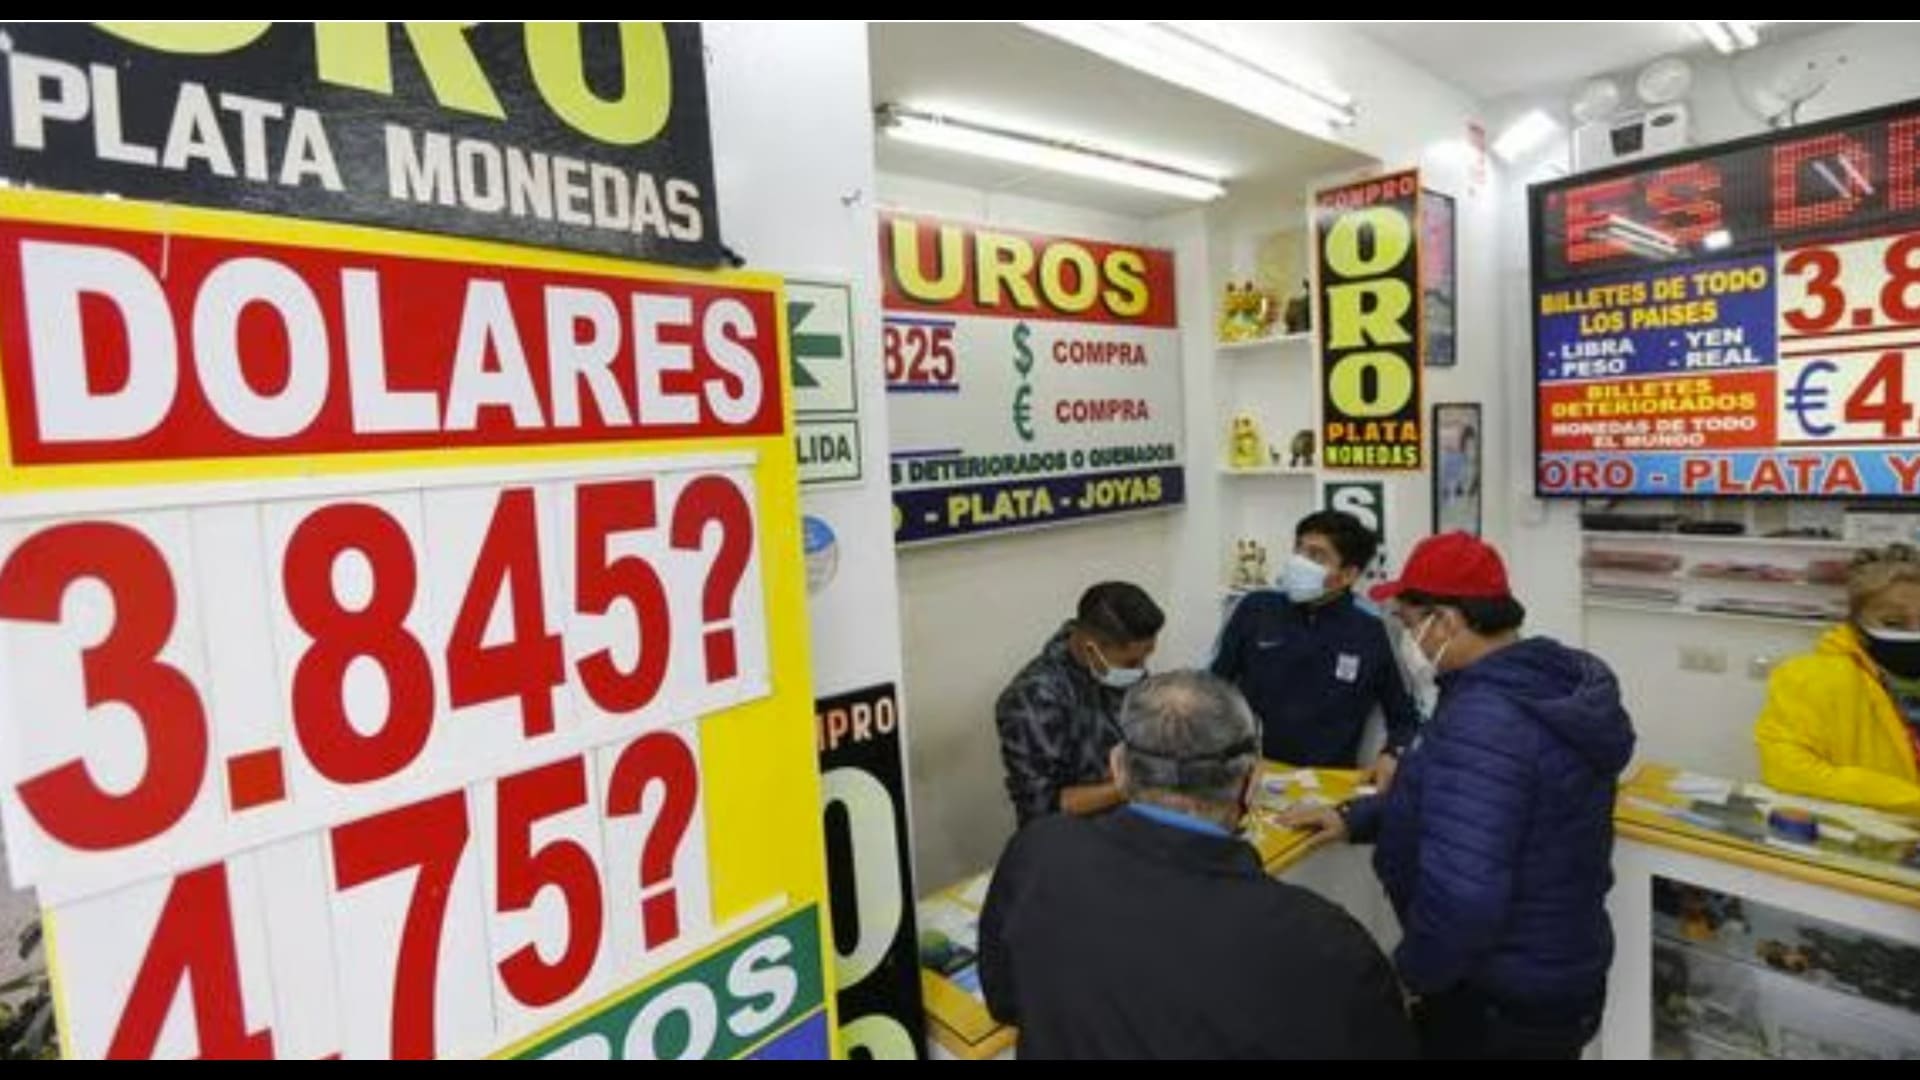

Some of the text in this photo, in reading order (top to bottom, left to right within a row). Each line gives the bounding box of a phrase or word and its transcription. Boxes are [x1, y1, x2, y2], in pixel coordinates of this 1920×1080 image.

[7, 50, 702, 243] PLATA MONEDAS
[891, 218, 1150, 318] UROS
[1541, 267, 1767, 315] BILLETES DE TODO
[1326, 206, 1413, 418] ORO
[1580, 300, 1718, 335] LOS PAISES
[19, 239, 763, 443] DOLARES
[1561, 338, 1635, 360] LIBRA
[1686, 327, 1743, 348] YEN
[1053, 340, 1147, 366] COMPRA
[1686, 347, 1760, 368] REAL
[1561, 358, 1626, 377] PESO
[1587, 378, 1712, 399] BILLETES
[1056, 399, 1149, 424] COMPRA
[1551, 392, 1756, 418] DETERIORADOS
[1328, 422, 1417, 442] PLATA
[1552, 415, 1757, 437] MONEDAS DE TODO
[796, 434, 852, 464] LIDA
[1592, 432, 1706, 449] EL MUNDO
[909, 452, 1066, 482] DETERIORADOS
[1071, 450, 1084, 467] O
[1326, 445, 1417, 466] MONEDAS
[1541, 458, 1634, 490] ORO
[1684, 456, 1864, 492] PLATA
[947, 487, 1054, 526] PLATA
[1078, 476, 1162, 508] JOYAS
